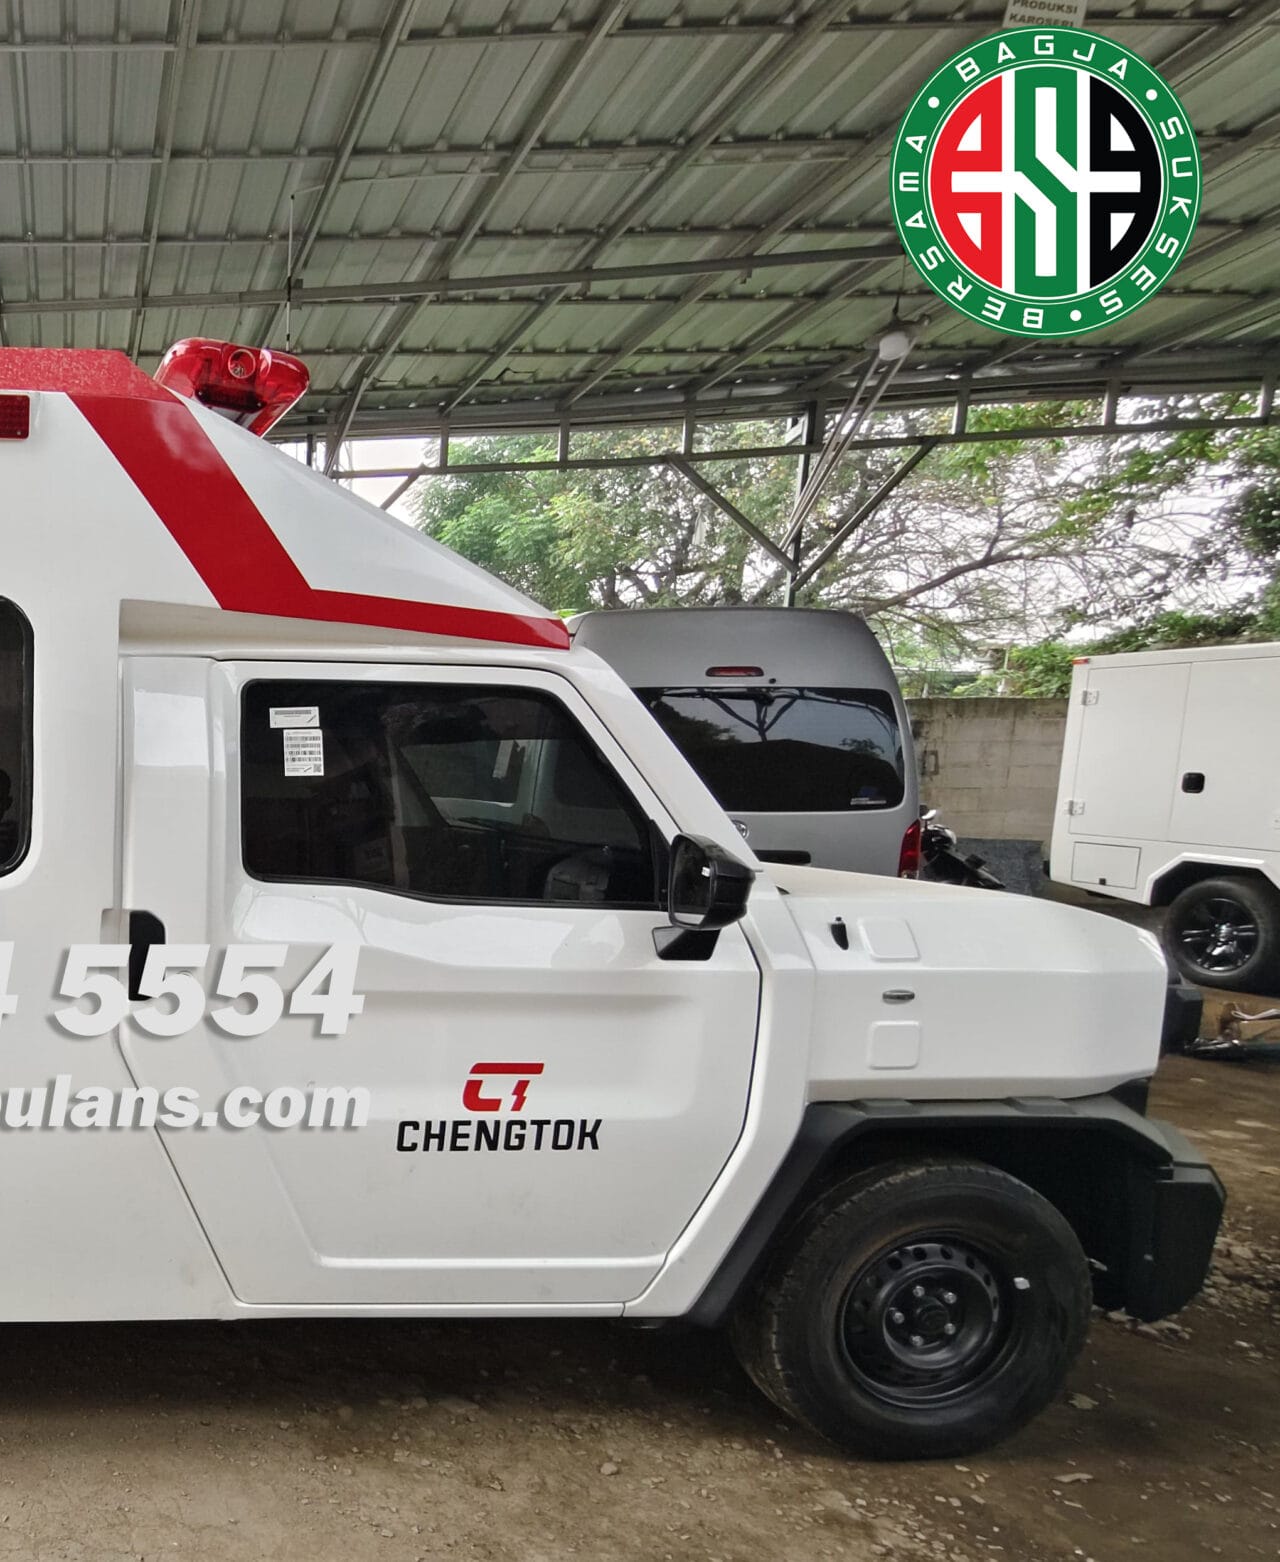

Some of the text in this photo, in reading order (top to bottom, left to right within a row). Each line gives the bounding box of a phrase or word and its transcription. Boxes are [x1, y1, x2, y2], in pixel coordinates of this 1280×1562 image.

[1012, 0, 1078, 14] PRODUKSI
[1009, 13, 1074, 27] KAROSERI
[396, 1118, 603, 1152] CHENGTOK
